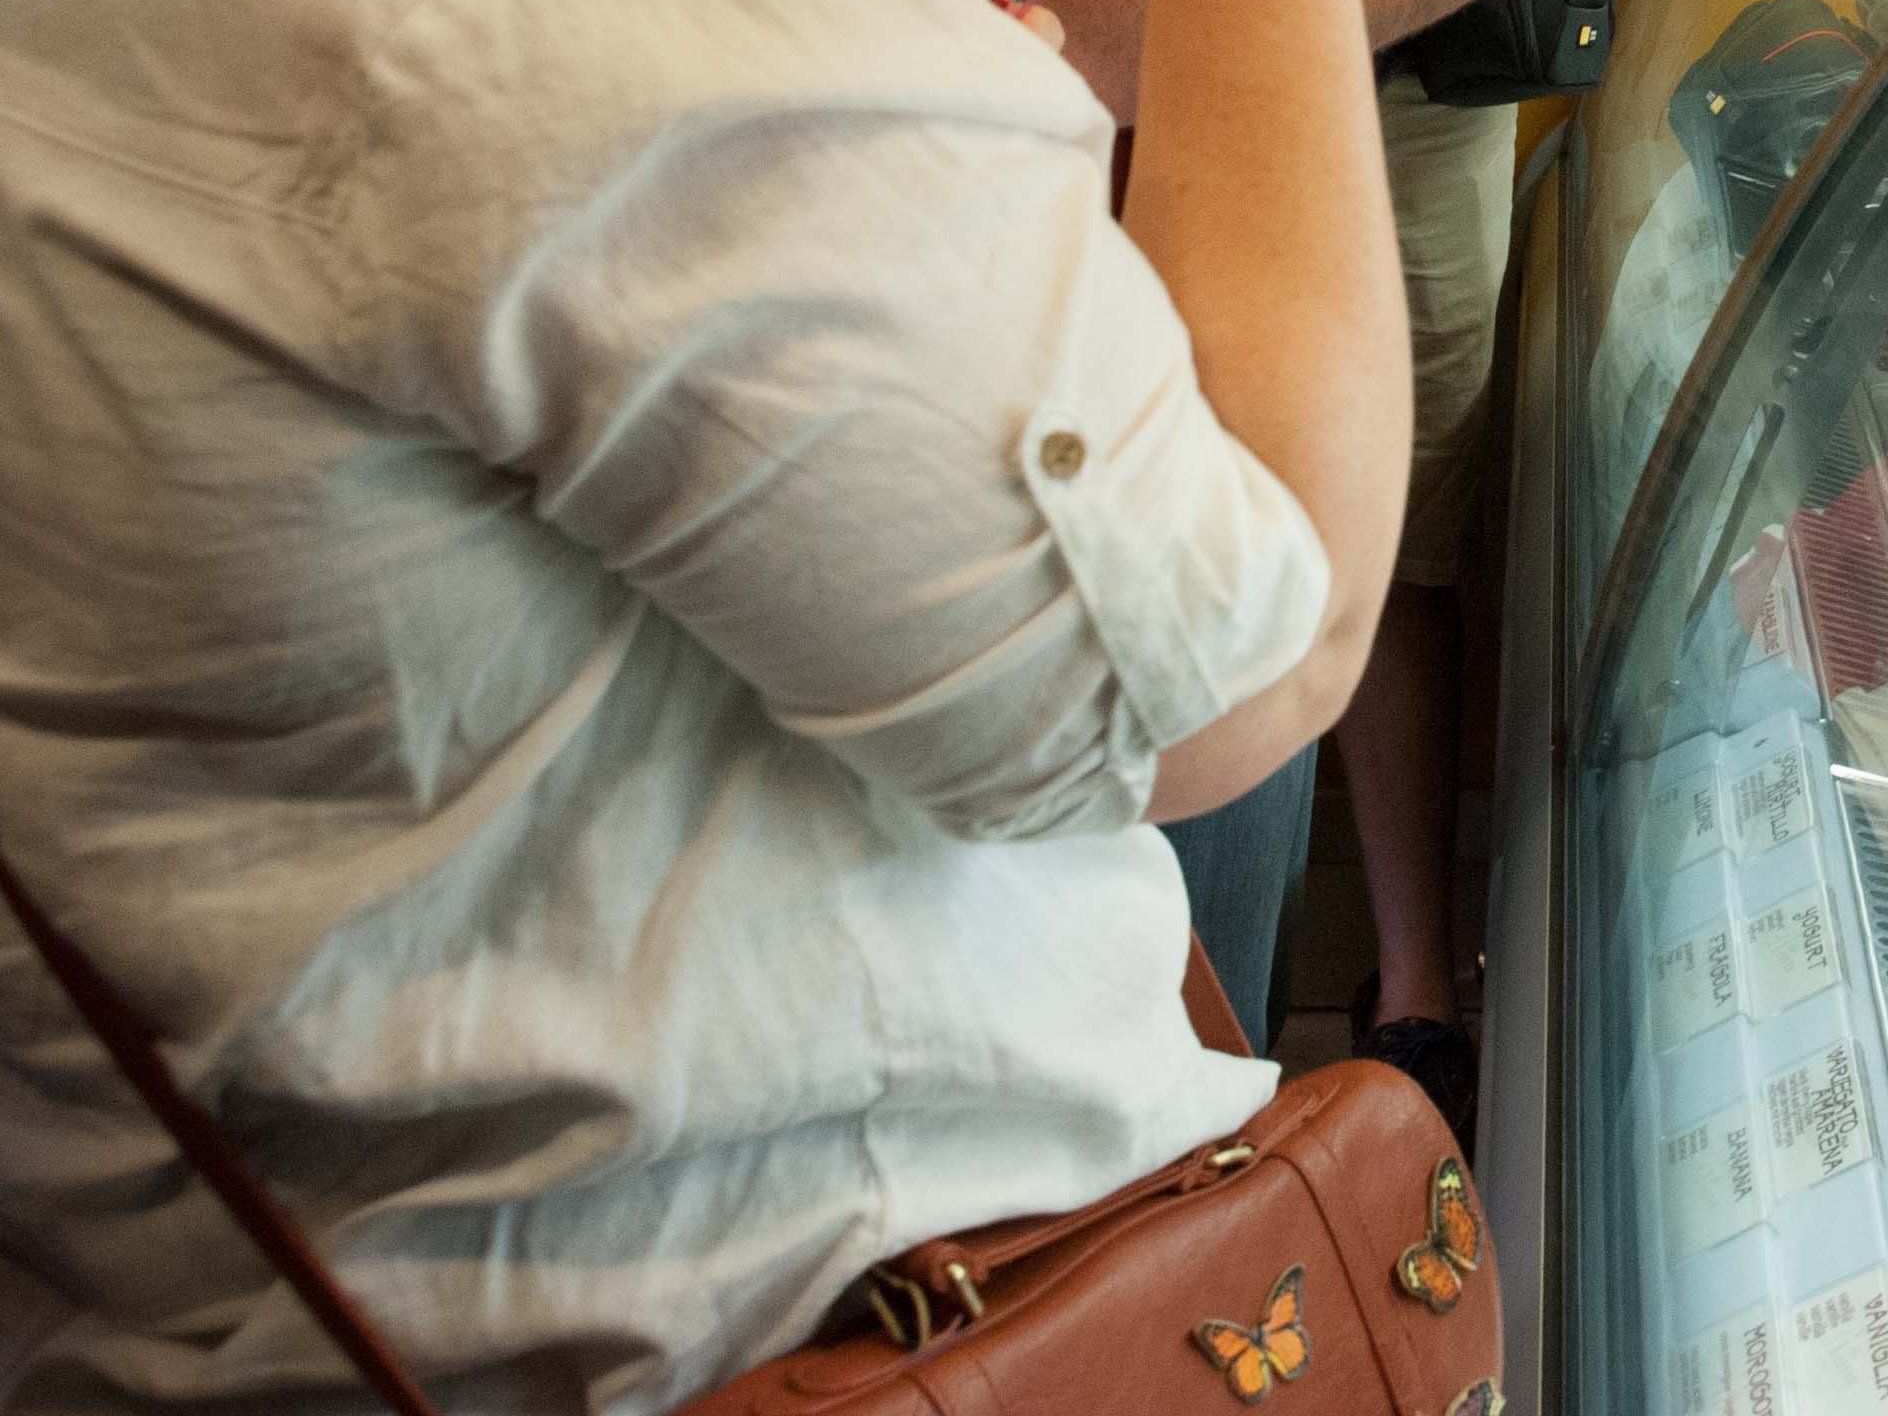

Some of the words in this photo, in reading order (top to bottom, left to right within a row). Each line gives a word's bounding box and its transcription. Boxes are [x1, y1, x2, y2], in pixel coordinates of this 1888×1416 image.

[1709, 932, 1733, 1008] FRAGOLA
[1793, 905, 1828, 970] YOGURT
[1826, 1044, 1859, 1134] VARIEGATO
[1727, 1127, 1753, 1203] BANANA
[1811, 1088, 1844, 1176] AMARENA
